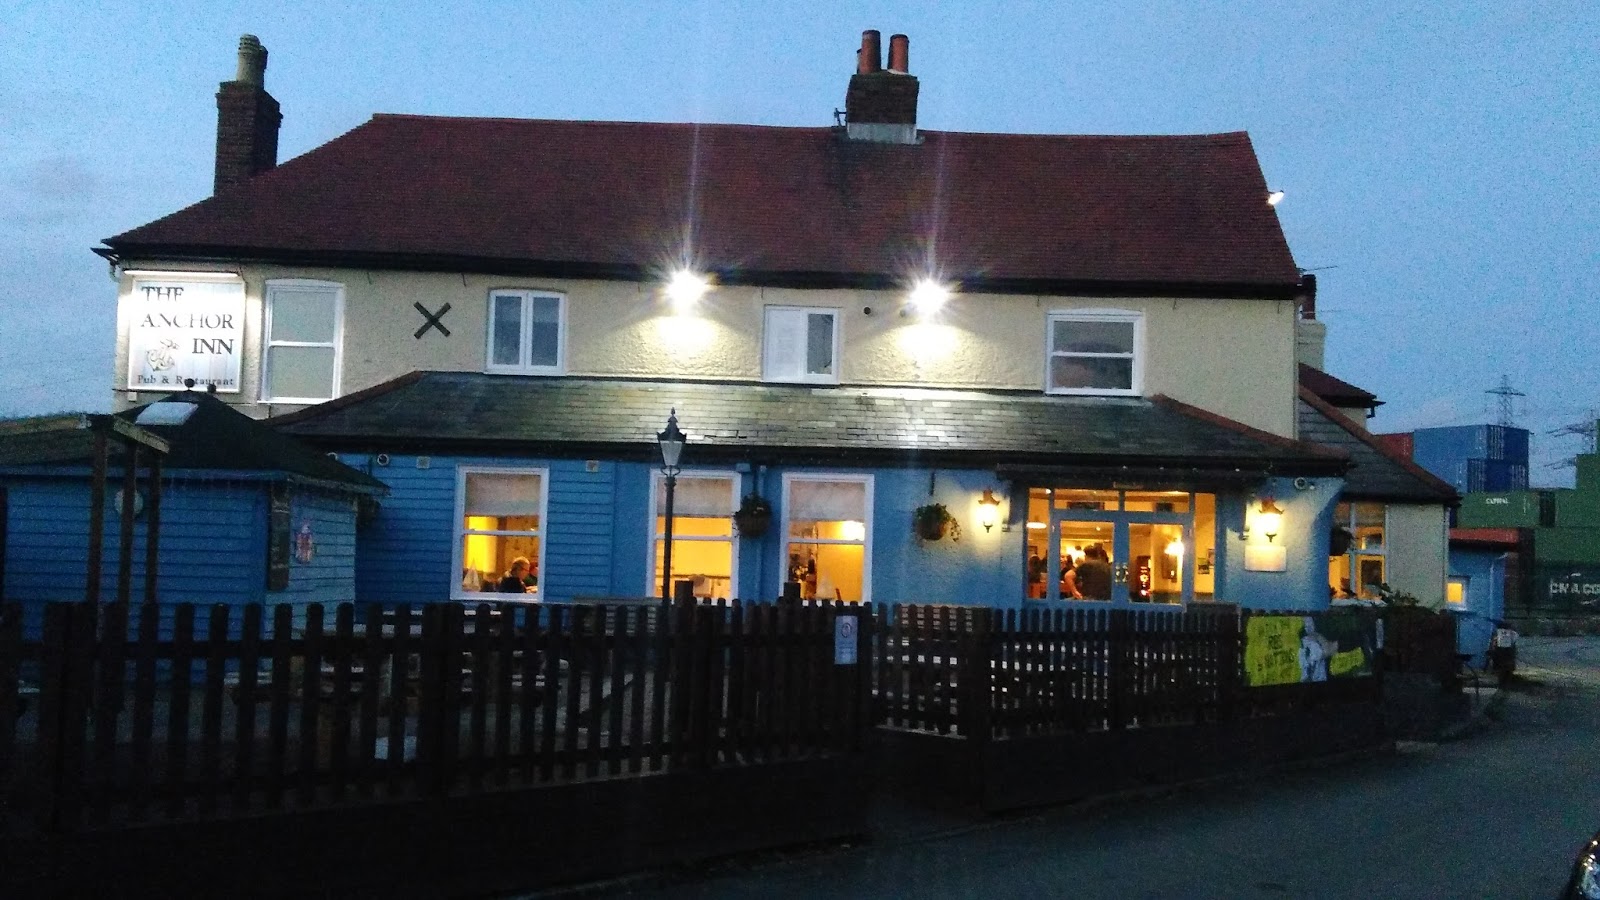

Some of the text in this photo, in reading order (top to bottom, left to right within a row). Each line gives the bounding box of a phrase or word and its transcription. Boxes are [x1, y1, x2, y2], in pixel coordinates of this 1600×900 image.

[141, 286, 184, 301] THE
[141, 313, 234, 329] ANCHOR
[192, 337, 234, 354] INN
[138, 375, 234, 386] Pub & Rtaurant
